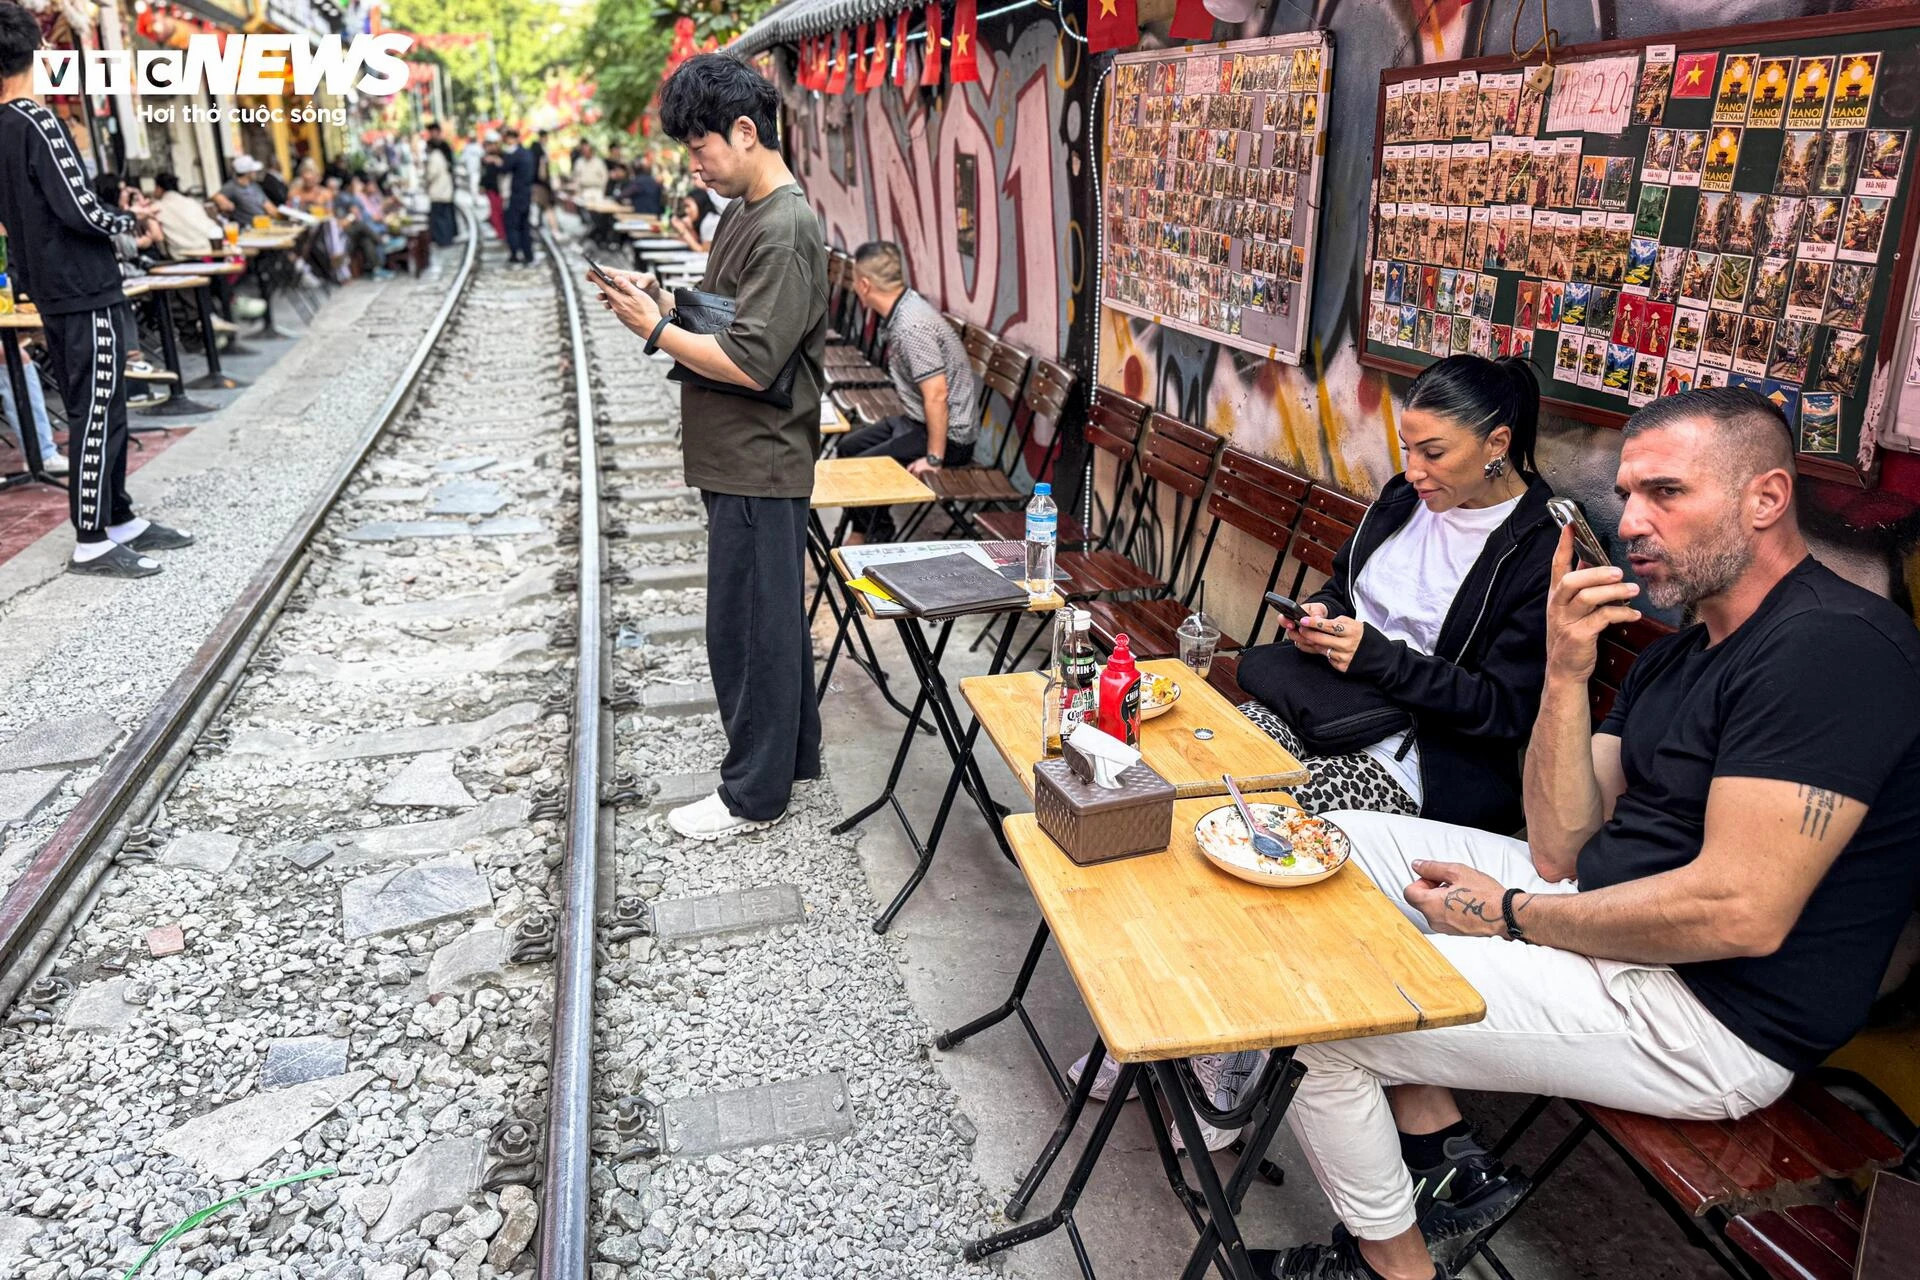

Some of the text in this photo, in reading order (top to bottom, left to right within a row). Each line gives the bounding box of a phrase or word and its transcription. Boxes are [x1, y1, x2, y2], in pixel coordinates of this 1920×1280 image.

[1717, 102, 1746, 112] HANOI
[1751, 107, 1782, 118] HANOI
[1790, 107, 1823, 118] HANOI
[1832, 106, 1867, 118] HANOI
[1714, 112, 1745, 121] VIETNAM
[40, 118, 56, 130] NY
[1749, 118, 1780, 127] VIETNAM
[1788, 118, 1821, 127] VIETNAM
[1830, 118, 1865, 127] VIETNAM
[51, 138, 65, 149] NY
[60, 157, 75, 168] NY
[1702, 171, 1732, 182] HANOI
[1701, 181, 1731, 190] VIETNAM
[78, 193, 93, 205] NY
[1601, 198, 1627, 207] VIETNAM
[1789, 313, 1817, 322] VIETNAM
[1587, 326, 1611, 337] VIETNAM
[98, 336, 112, 347] NY
[98, 353, 112, 364] NY
[96, 370, 112, 381] NY
[96, 387, 111, 399] NY
[87, 437, 103, 448] NY
[84, 454, 100, 465] NY
[82, 472, 98, 482] NY
[82, 488, 97, 498] NY
[82, 503, 96, 515] NY
